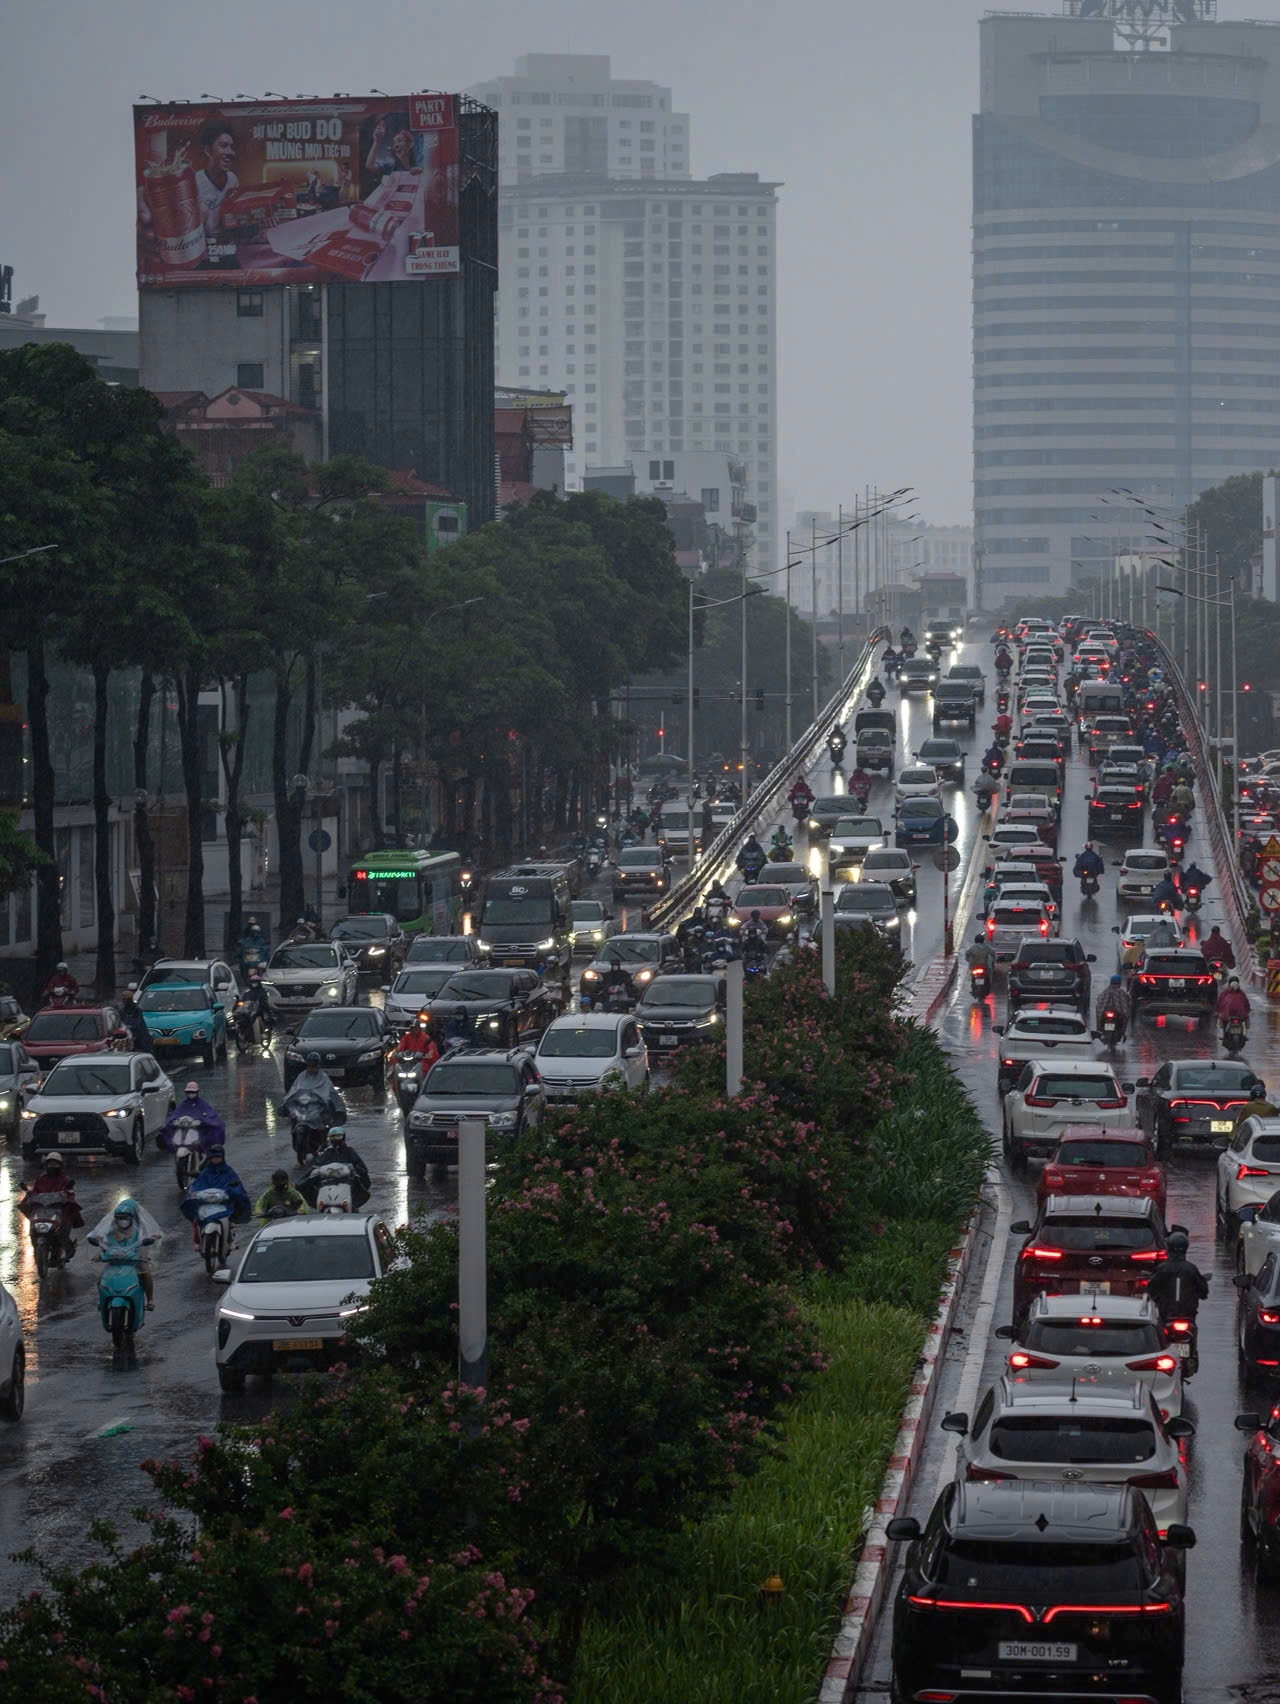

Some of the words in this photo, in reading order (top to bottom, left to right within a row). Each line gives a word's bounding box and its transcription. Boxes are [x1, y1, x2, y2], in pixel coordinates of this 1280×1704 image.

[415, 100, 445, 113] PARTY
[420, 113, 443, 126] PACK
[286, 121, 311, 140] BUD
[412, 262, 432, 271] TRONG
[1005, 1645, 1070, 1658] 30M-001.59
